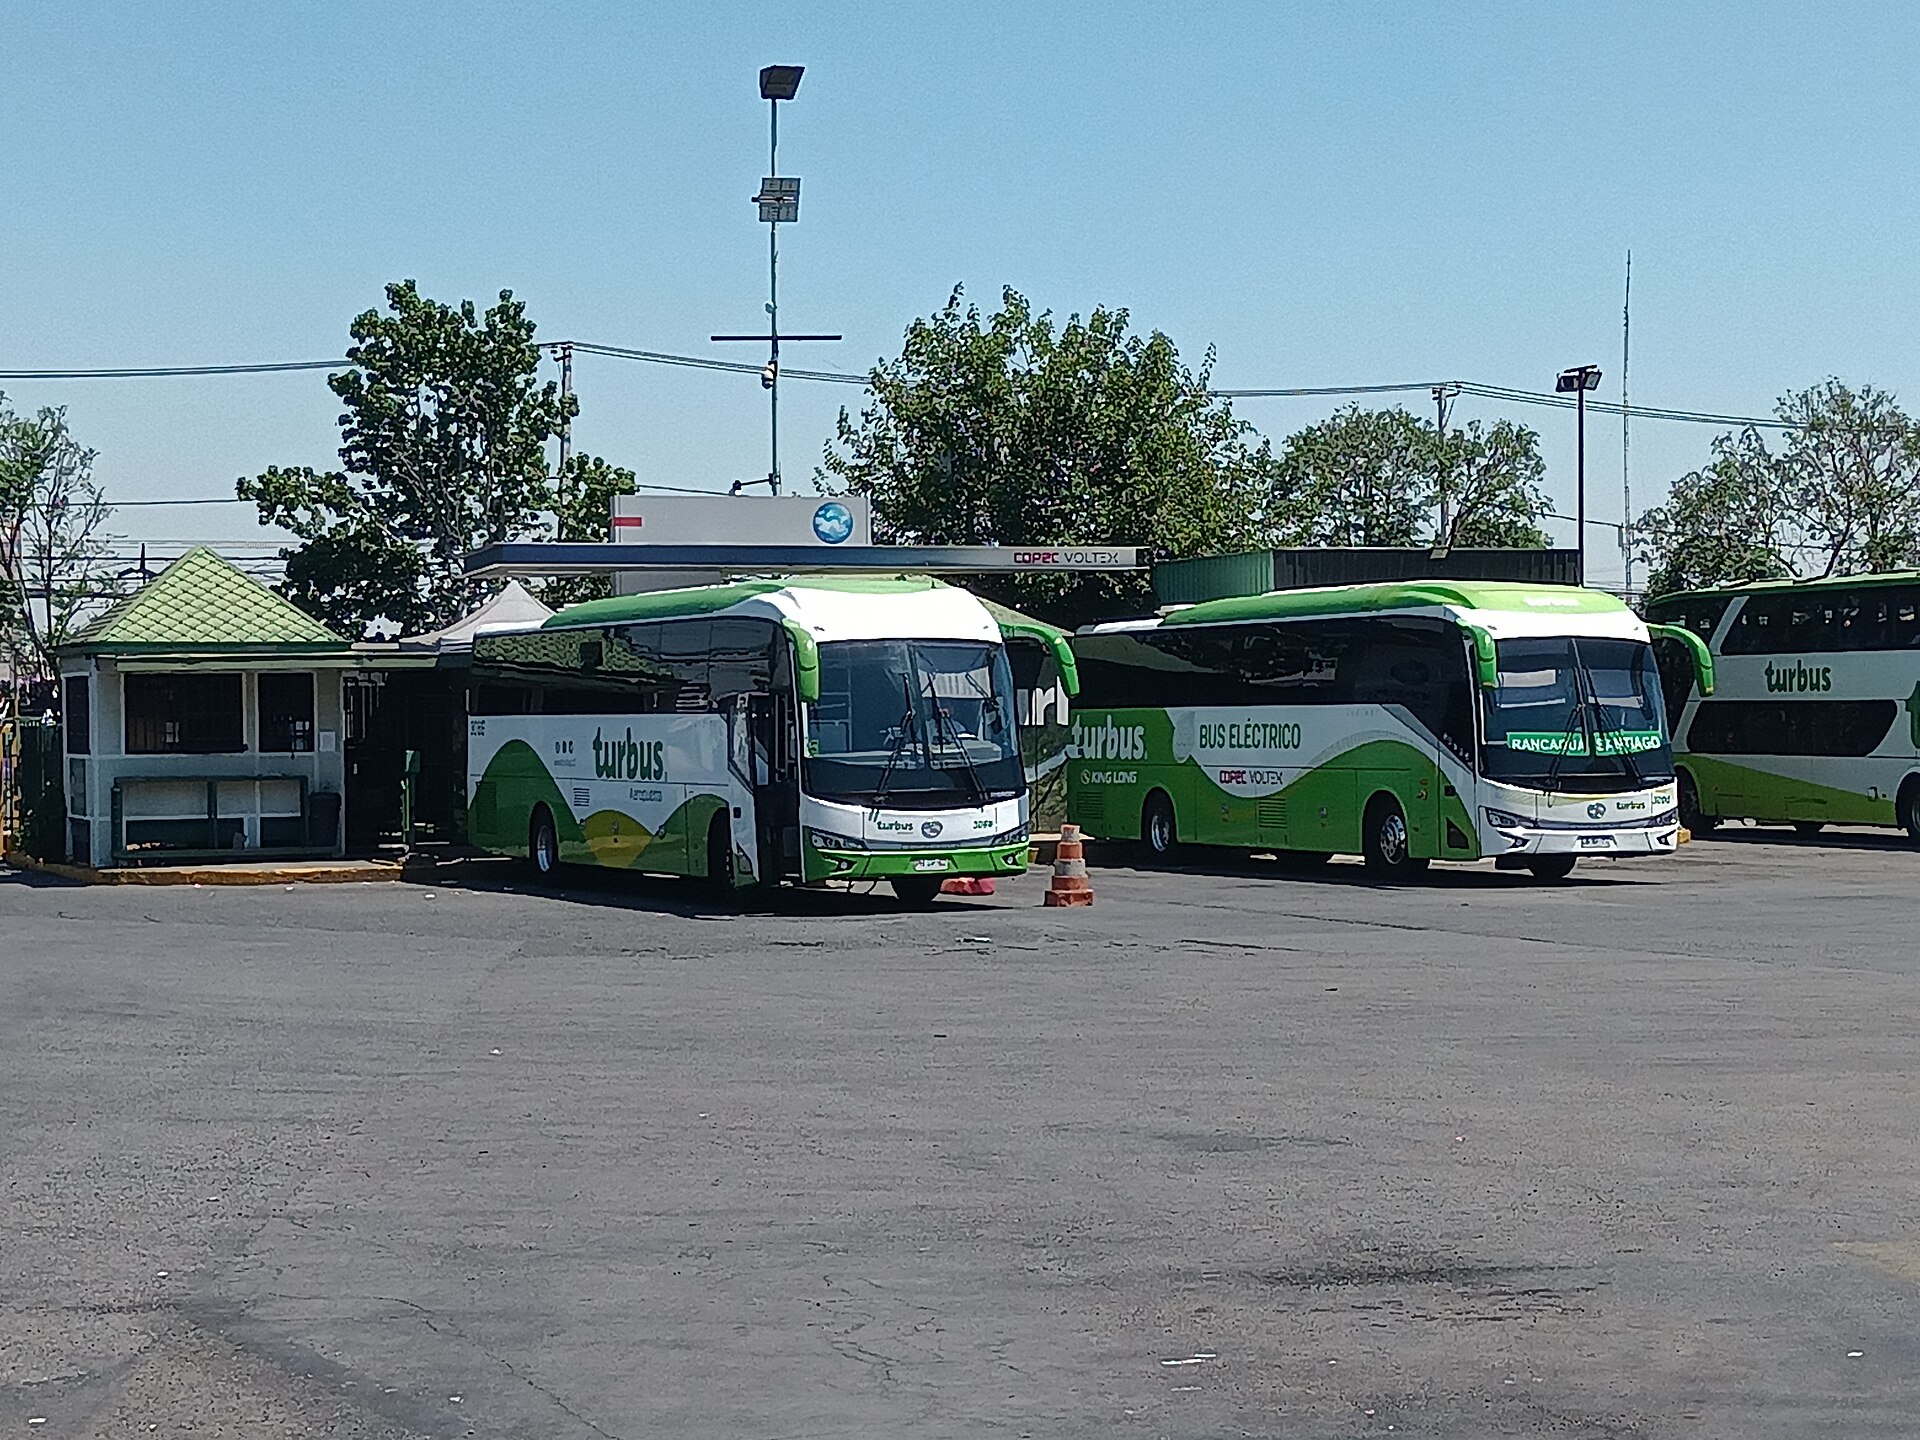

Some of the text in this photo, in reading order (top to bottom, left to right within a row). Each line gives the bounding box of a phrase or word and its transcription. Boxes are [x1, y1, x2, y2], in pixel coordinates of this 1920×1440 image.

[1013, 552, 1119, 563] COPEC VOLTEX
[1764, 659, 1832, 692] turbus
[1067, 714, 1145, 760] turbus
[1199, 717, 1301, 749] BUS ELÉCTRICO
[592, 726, 664, 780] turbus
[1091, 771, 1138, 784] KING LONG
[1219, 769, 1247, 784] COPEC
[1615, 801, 1646, 811] turbus
[876, 820, 914, 831] turbus
